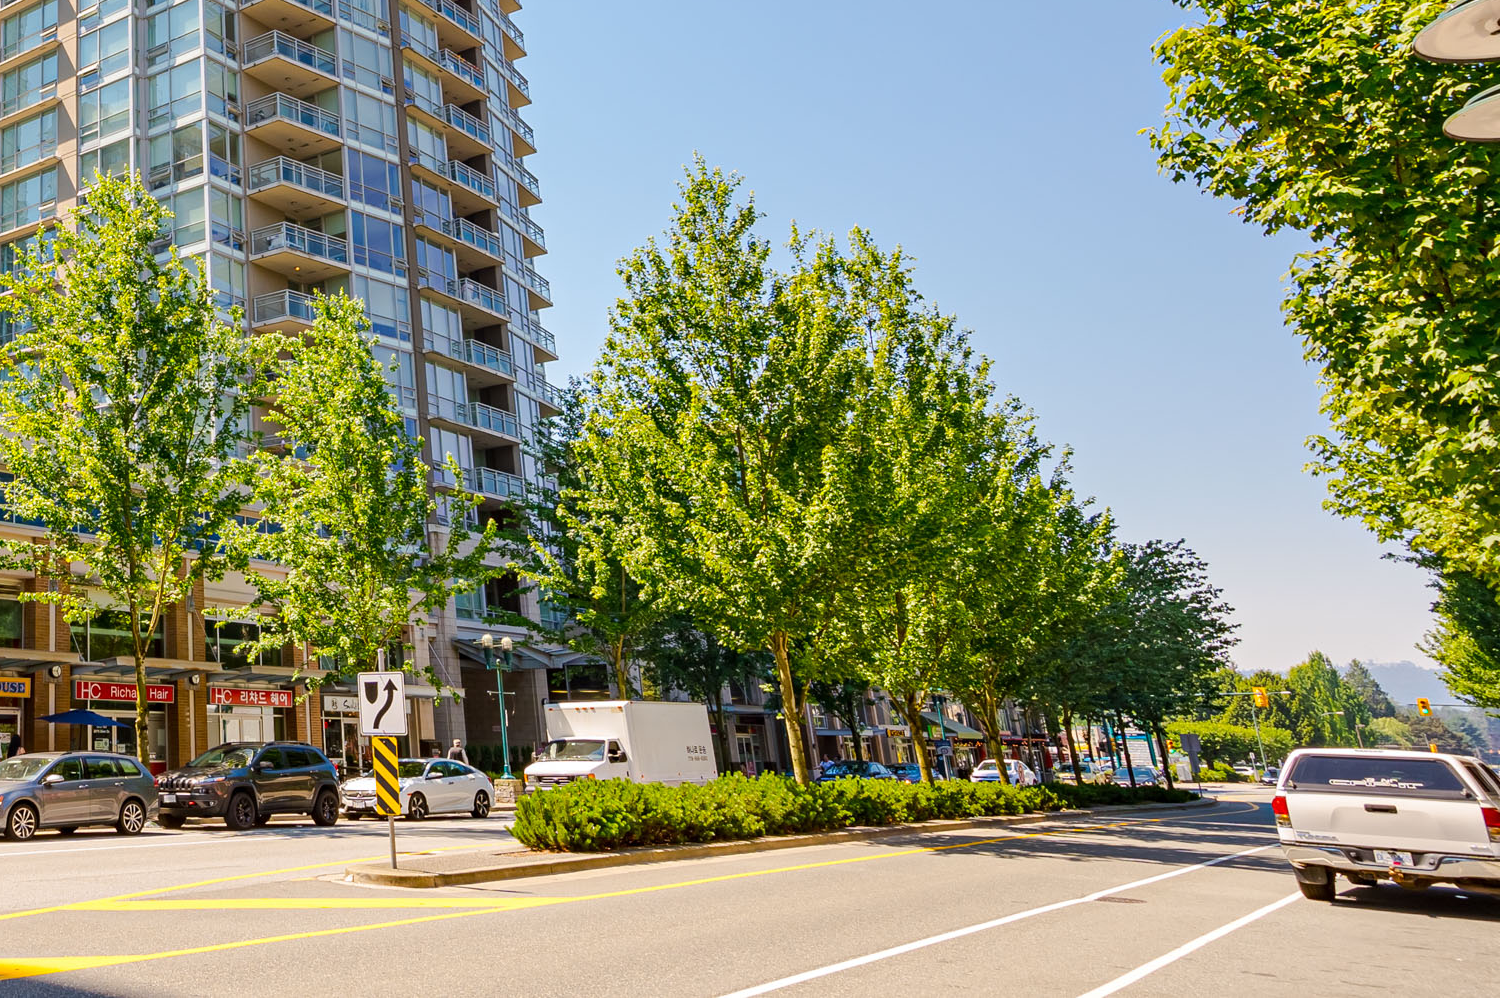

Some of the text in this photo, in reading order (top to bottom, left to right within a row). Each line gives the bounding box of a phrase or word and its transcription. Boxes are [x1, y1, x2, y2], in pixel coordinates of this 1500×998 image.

[81, 682, 169, 700] HC Richa Hair
[215, 687, 232, 704] HC
[270, 692, 288, 706] 헤어
